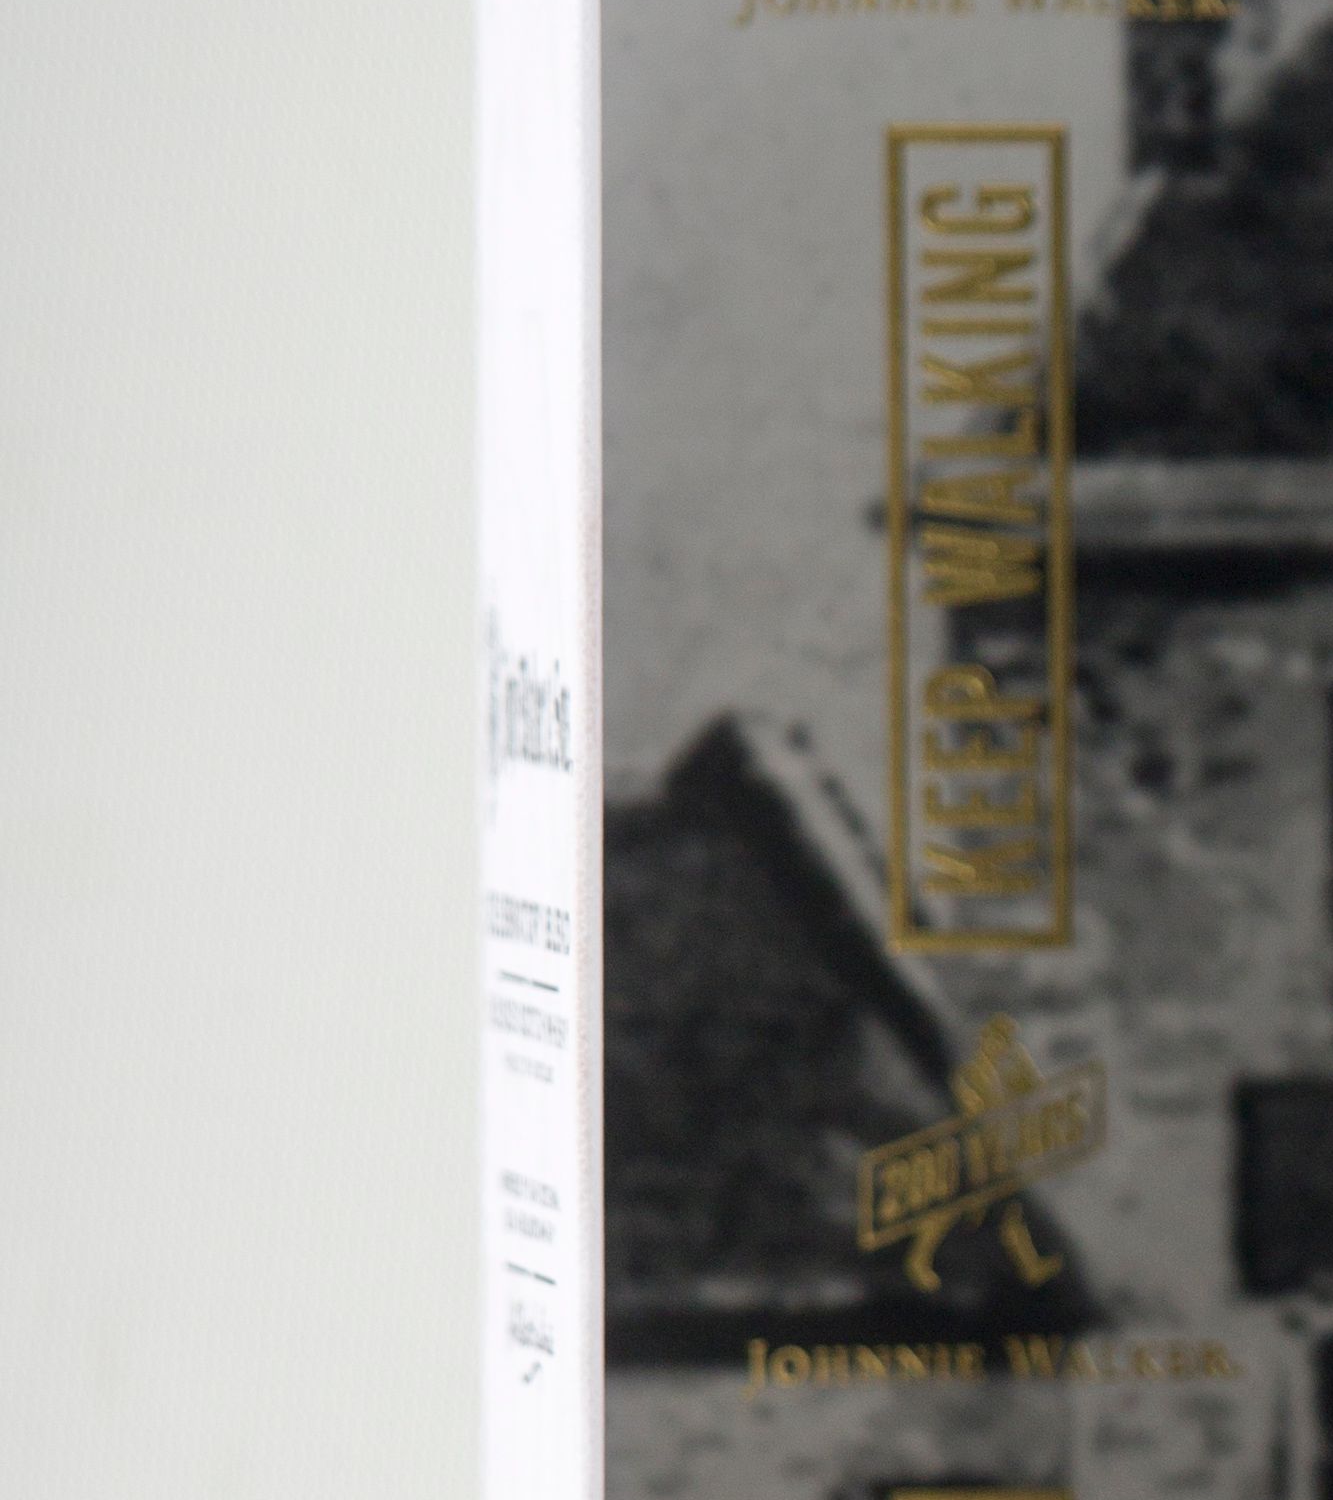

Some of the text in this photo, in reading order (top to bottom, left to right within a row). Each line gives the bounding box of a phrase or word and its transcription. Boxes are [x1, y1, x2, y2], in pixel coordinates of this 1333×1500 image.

[920, 184, 1043, 896] KEEP WALKING
[742, 1338, 986, 1397] JOHNNIE
